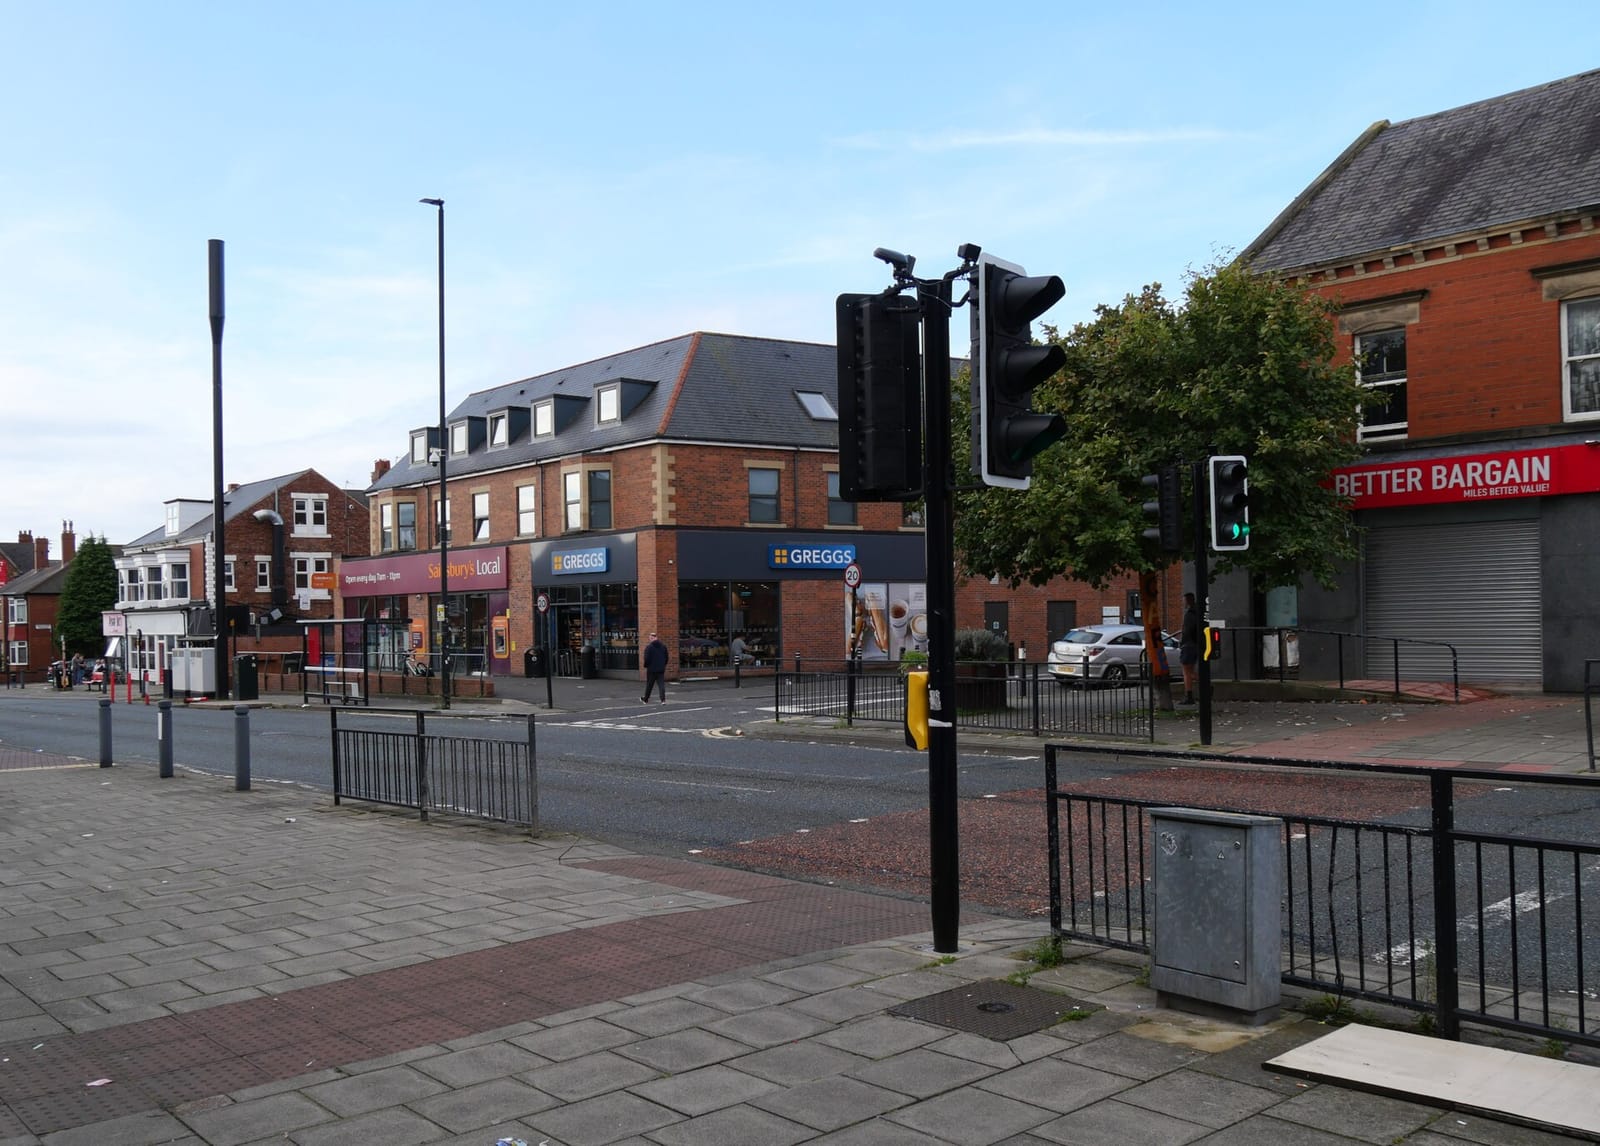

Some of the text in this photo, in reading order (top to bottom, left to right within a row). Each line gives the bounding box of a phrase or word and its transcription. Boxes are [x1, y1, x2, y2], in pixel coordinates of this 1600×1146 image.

[1335, 455, 1550, 497] BETTER BARGAIN
[1463, 484, 1550, 498] MILES BETTER VALUE!
[563, 552, 604, 569] GREGGS
[790, 549, 852, 564] GREGGS
[428, 556, 501, 580] Saisbury's Local
[345, 575, 356, 584] Open
[357, 575, 368, 584] every
[368, 573, 376, 583] day
[847, 570, 858, 581] 20
[538, 599, 547, 608] 20
